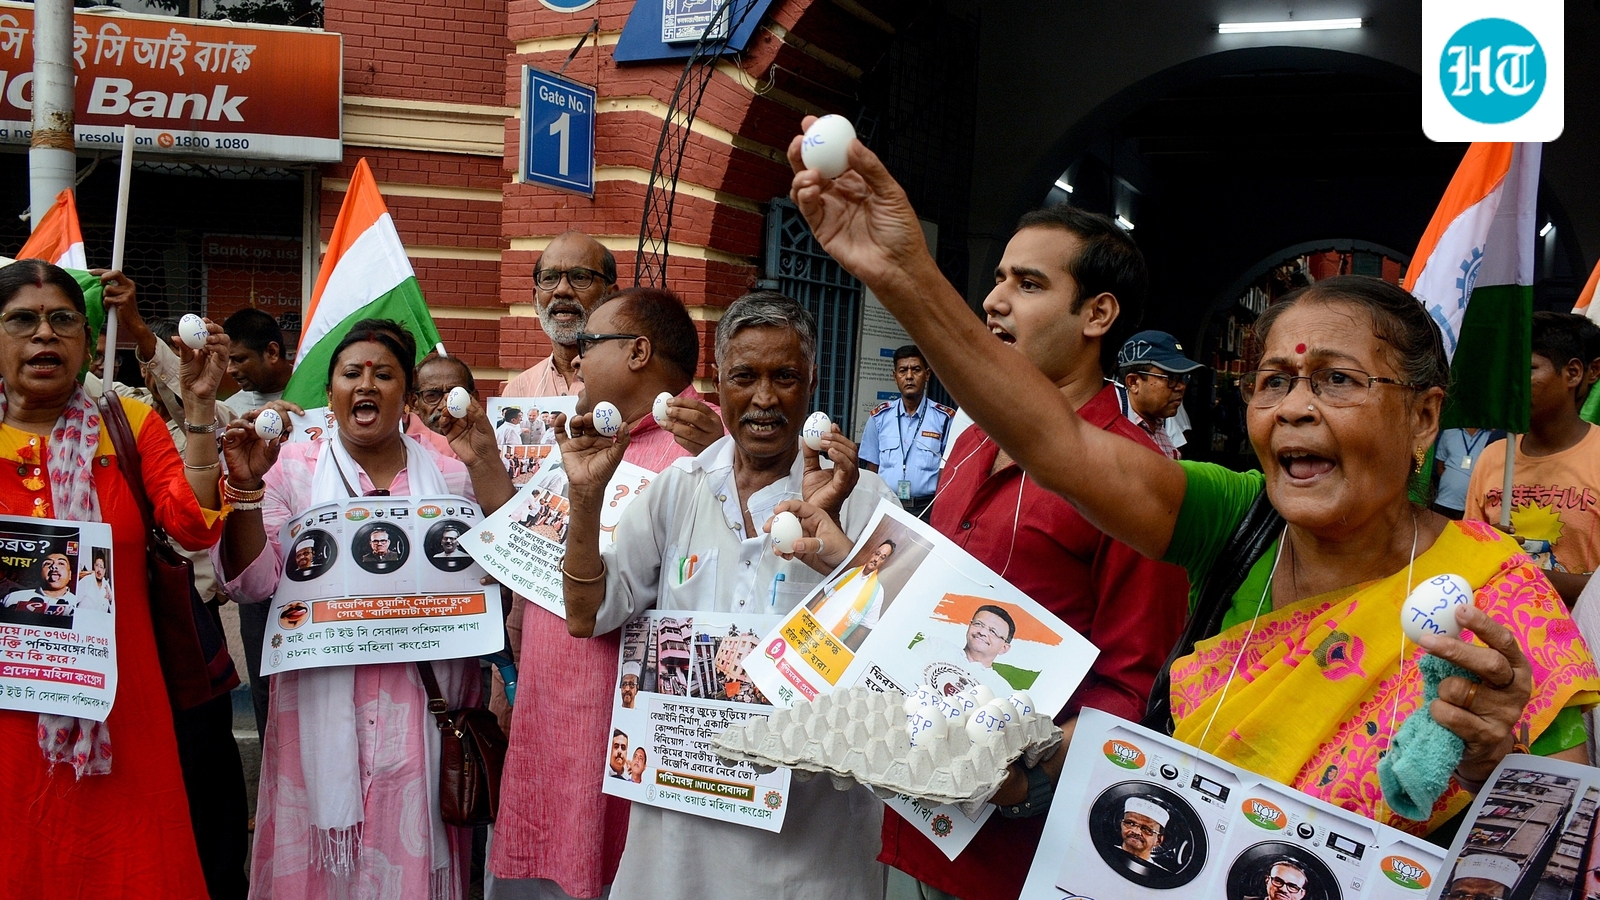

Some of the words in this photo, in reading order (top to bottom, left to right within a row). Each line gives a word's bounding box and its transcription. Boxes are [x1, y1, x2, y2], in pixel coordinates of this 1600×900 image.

[133, 28, 191, 76] আই
[194, 41, 257, 74] ব্যাঙ্ক
[87, 77, 249, 122] Bank
[539, 85, 566, 106] Gate
[568, 94, 586, 114] No.
[175, 136, 210, 149] 1800
[215, 138, 250, 151] 1080
[549, 111, 570, 177] 1
[802, 134, 825, 152] MC
[208, 243, 249, 257] Bank
[253, 248, 271, 258] on
[595, 408, 614, 418] BJP
[601, 424, 620, 434] TMC
[604, 416, 610, 427] ?
[263, 426, 280, 435] TMC
[1486, 484, 1598, 511] うまきナルト
[524, 531, 546, 546] কাদের
[507, 540, 531, 558] কাদের
[494, 543, 512, 560] আই
[510, 557, 524, 567] এন
[523, 561, 533, 572] টি
[542, 570, 552, 583] সি
[535, 584, 558, 603] মহিলা
[326, 599, 373, 610] বিজেপির
[414, 595, 448, 606] মেশিনে
[1431, 598, 1448, 616] ?
[337, 609, 364, 618] গেছে
[23, 629, 41, 638] IPC
[85, 635, 95, 644] IPC
[286, 632, 304, 643] আই
[306, 631, 322, 640] এন
[325, 628, 335, 639] টি
[337, 626, 354, 639] ইউ
[357, 626, 368, 637] সি
[372, 626, 409, 637] সেবাদল
[457, 621, 480, 631] শাখা
[25, 638, 86, 655] পশ্চিমবঙ্গের
[357, 641, 394, 653] মহিলা
[397, 639, 440, 650] কংগ্রেস
[5, 649, 26, 660] হন
[27, 649, 44, 662] কি
[46, 653, 69, 664] করে
[3, 665, 40, 677] প্রদেশ
[41, 667, 73, 681] মহিলা
[75, 671, 102, 686] কংগ্রেস
[25, 686, 36, 700] সি
[663, 703, 677, 712] সারা
[679, 704, 695, 714] শহর
[650, 712, 677, 723] বেআইনি
[975, 710, 1005, 731] BJP
[655, 724, 695, 736] কোম্পানিতে
[654, 733, 684, 746] বিনিয়োগ
[653, 745, 683, 758] হাকিমের
[661, 756, 690, 769] বিজেপি
[690, 763, 714, 774] এবারে
[715, 767, 736, 778] নেবে
[738, 770, 752, 780] তো
[754, 773, 760, 781] ?
[658, 771, 693, 788] পশ্চিমবঙ্গ
[694, 780, 716, 791] INTUC
[716, 783, 749, 797] সেবাদল
[684, 794, 708, 807] ওয়ার্ড
[709, 797, 736, 813] মহিলা
[739, 804, 773, 820] কংগ্রেস
